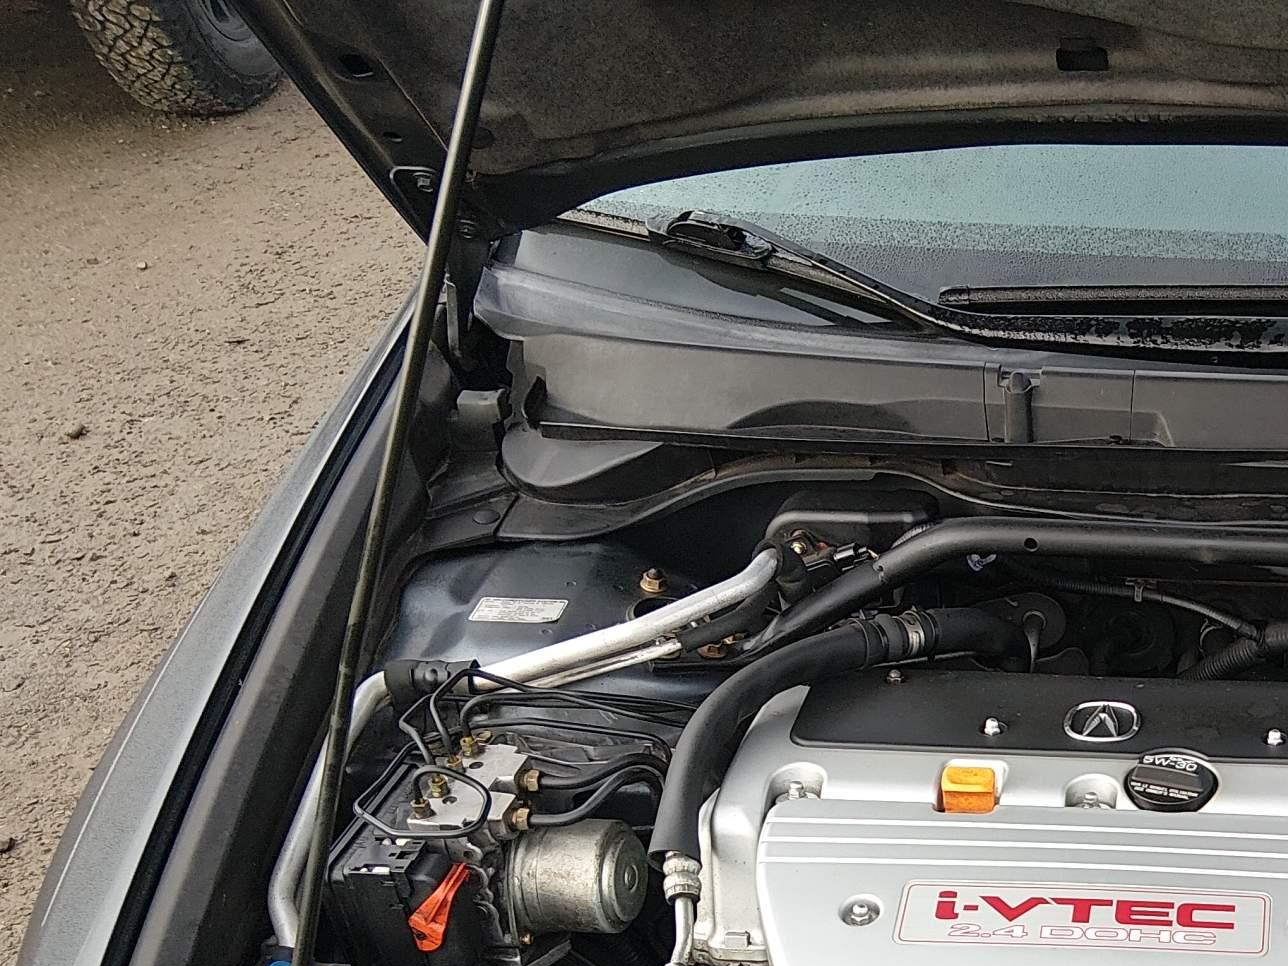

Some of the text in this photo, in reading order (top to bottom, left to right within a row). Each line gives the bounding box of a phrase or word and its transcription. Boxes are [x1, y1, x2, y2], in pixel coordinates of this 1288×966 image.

[1143, 755, 1198, 772] 5W-30
[935, 890, 1236, 930] i-VTEC
[947, 922, 1217, 946] 2.4 DOHC
